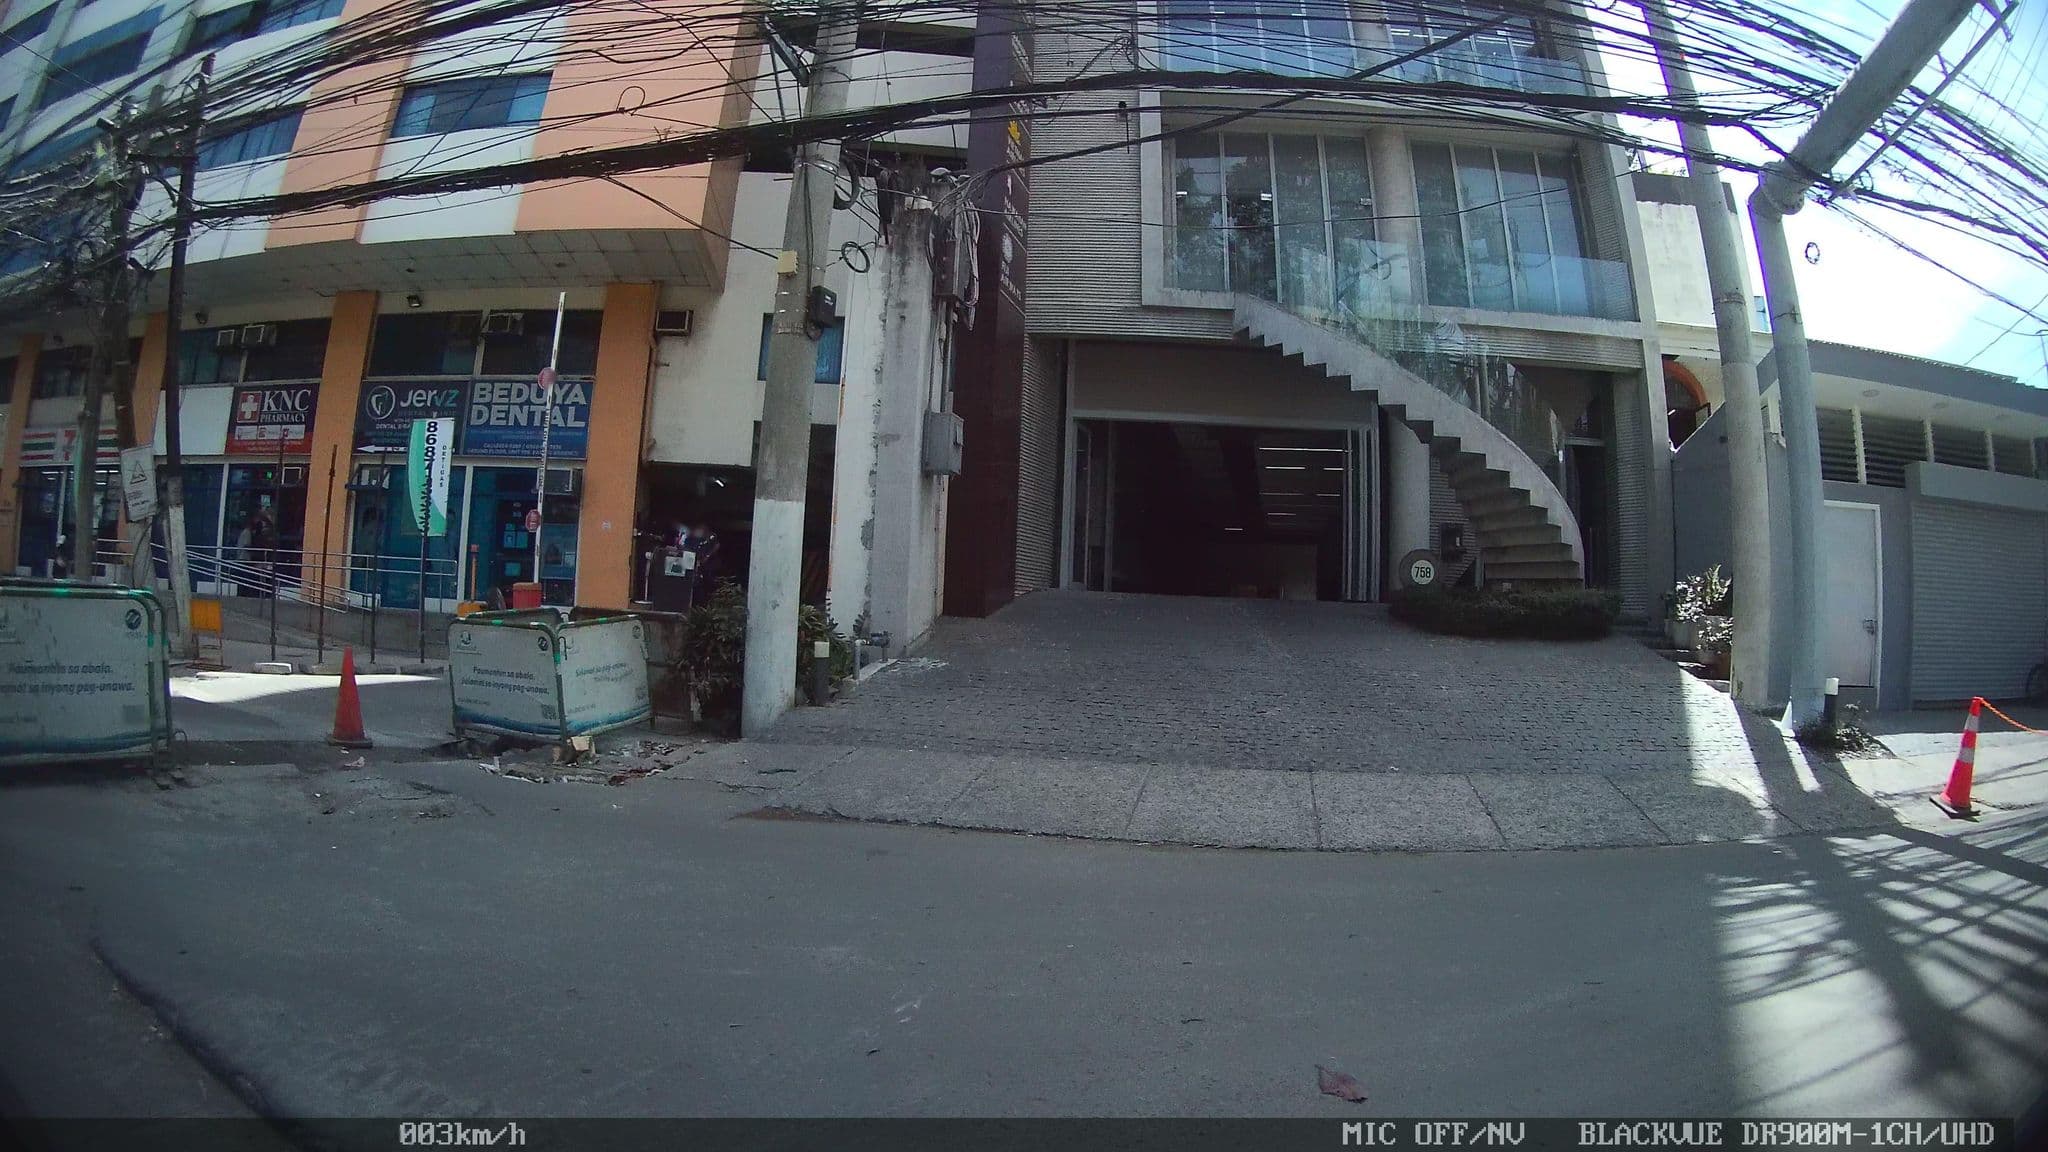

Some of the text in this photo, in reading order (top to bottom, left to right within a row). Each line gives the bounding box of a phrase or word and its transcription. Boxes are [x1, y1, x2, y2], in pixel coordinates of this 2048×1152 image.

[261, 389, 311, 412] KNC
[473, 382, 587, 405] BEDUYA
[260, 413, 305, 423] PHARMACY
[470, 404, 585, 427] DENTAL
